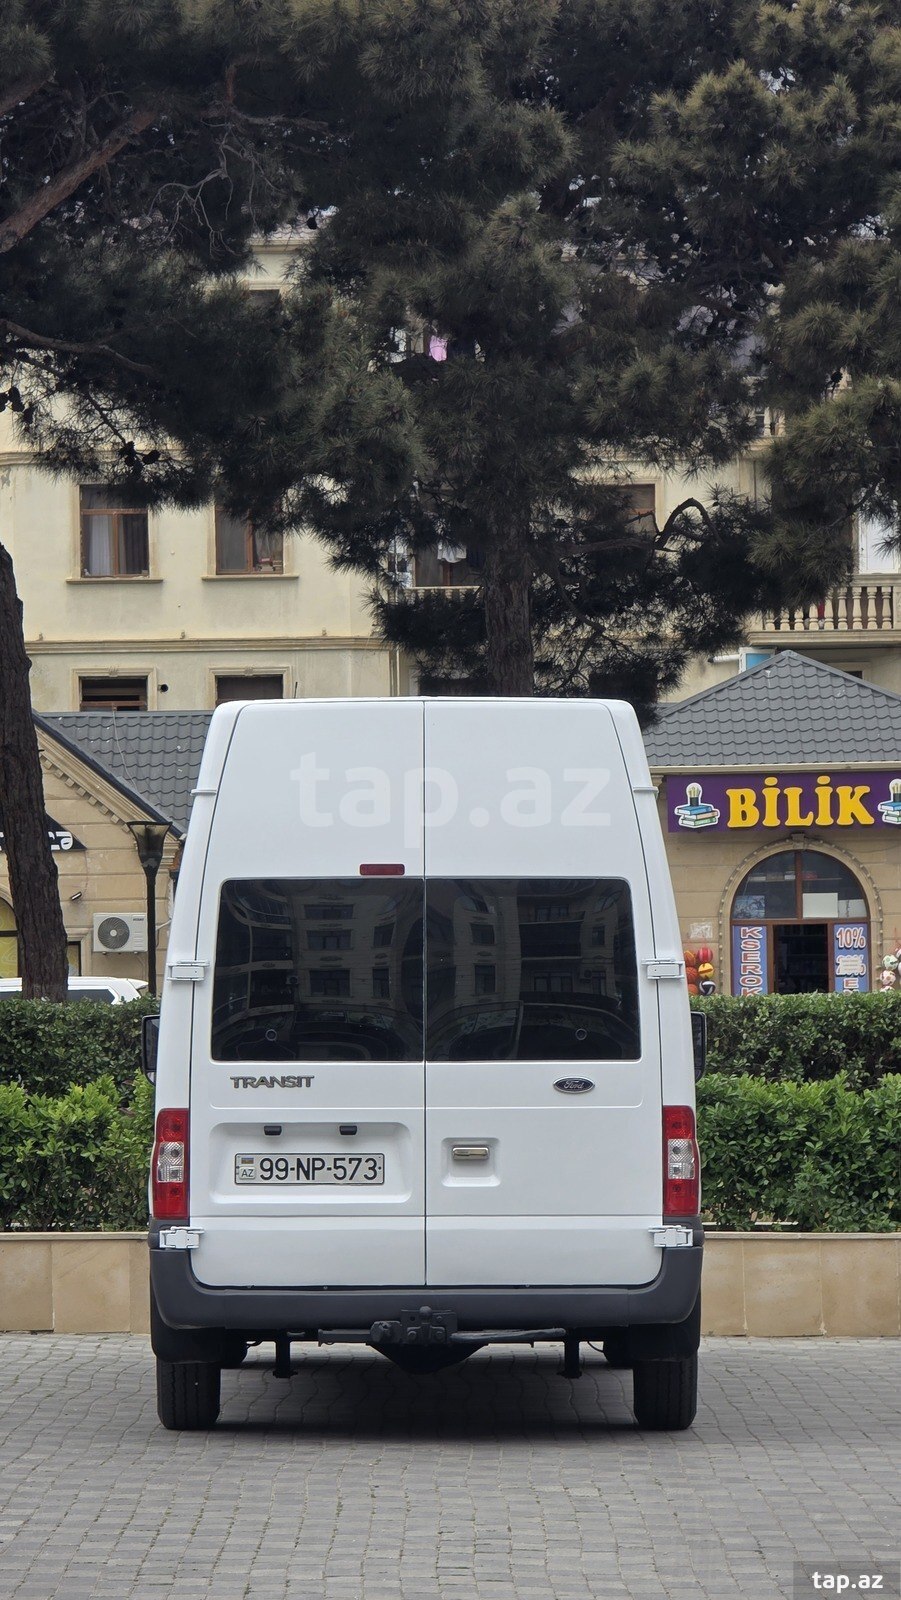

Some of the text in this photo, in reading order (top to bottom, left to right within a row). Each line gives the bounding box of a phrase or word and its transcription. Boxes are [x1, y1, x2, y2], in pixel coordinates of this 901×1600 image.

[725, 775, 875, 828] BİLİK
[836, 927, 866, 949] 10%
[229, 1075, 315, 1089] TRANSIT
[241, 1169, 254, 1178] AZ
[259, 1157, 378, 1181] 99-NP-573
